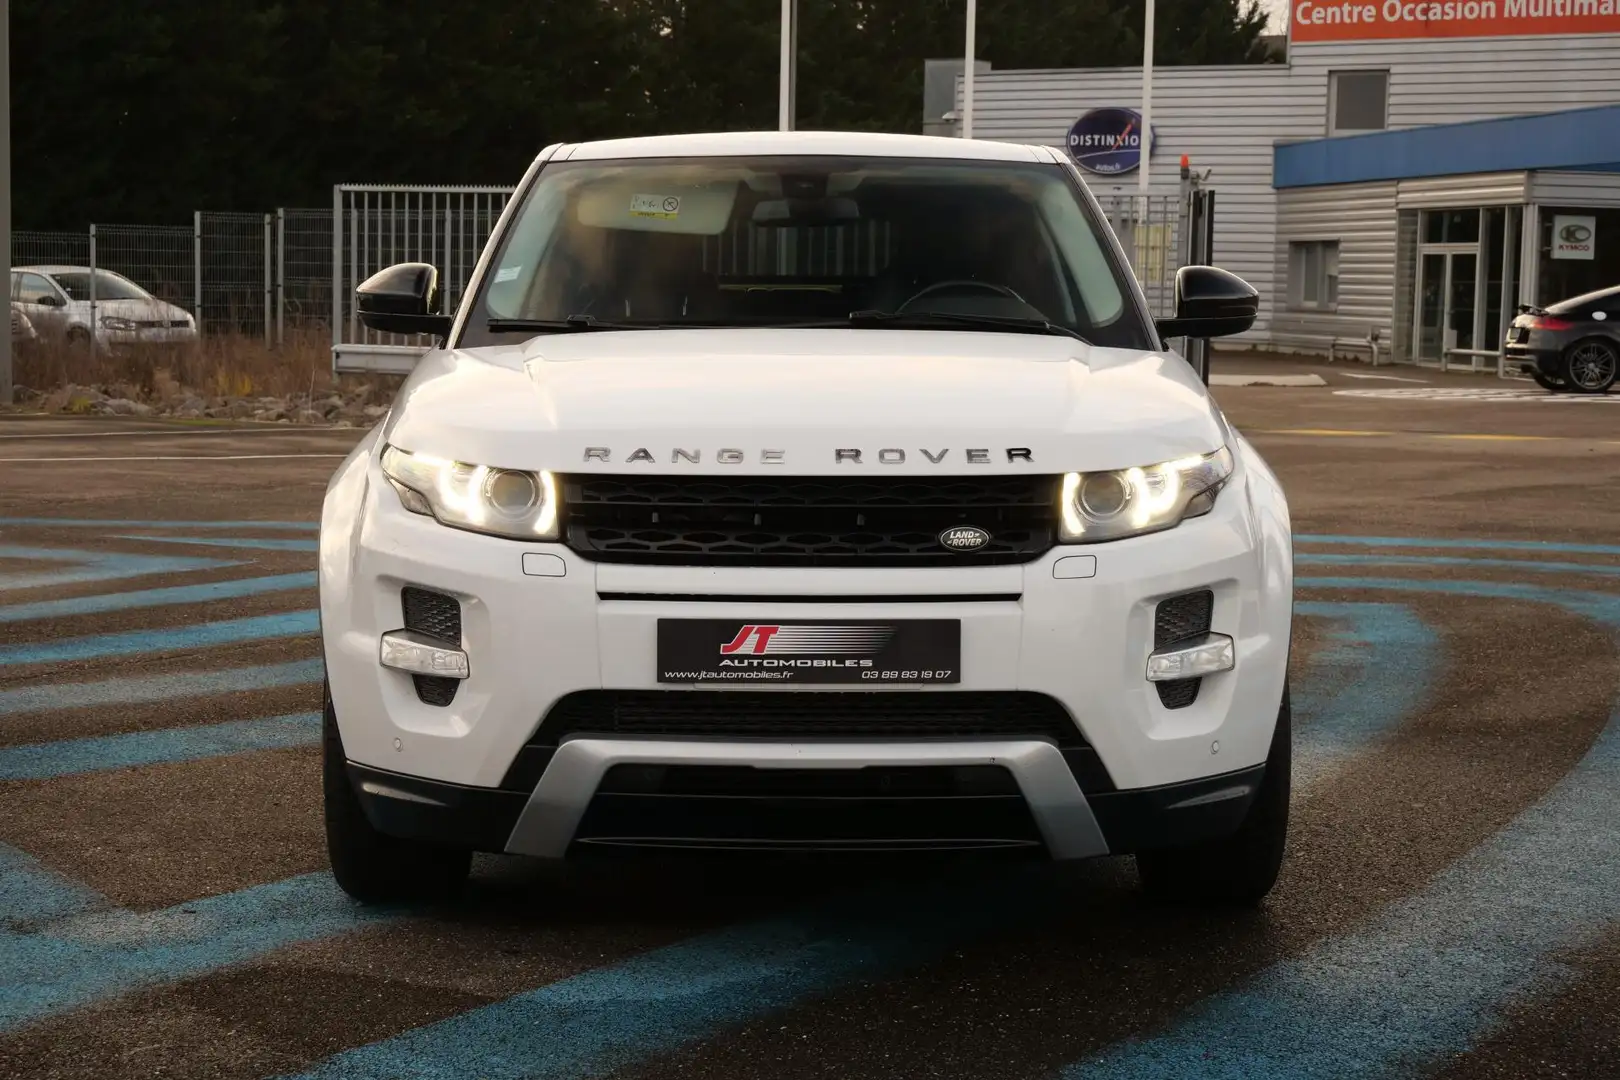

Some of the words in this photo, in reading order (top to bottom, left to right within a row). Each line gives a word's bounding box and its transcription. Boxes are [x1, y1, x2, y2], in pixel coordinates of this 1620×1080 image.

[1296, 1, 1376, 25] Centre
[1382, 0, 1496, 22] Occasion
[1070, 134, 1140, 146] DISTINXIO
[583, 446, 786, 465] RANGE
[834, 447, 1035, 465] ROVER
[952, 538, 982, 546] ROVER
[720, 624, 780, 655] JT
[719, 659, 873, 667] AUTOMOBILES
[664, 670, 794, 680] www.jtautomobiles.fr
[861, 670, 879, 679] 03
[881, 670, 899, 679] 89
[901, 670, 918, 679] 83
[920, 670, 933, 679] 19
[935, 670, 952, 679] 07
